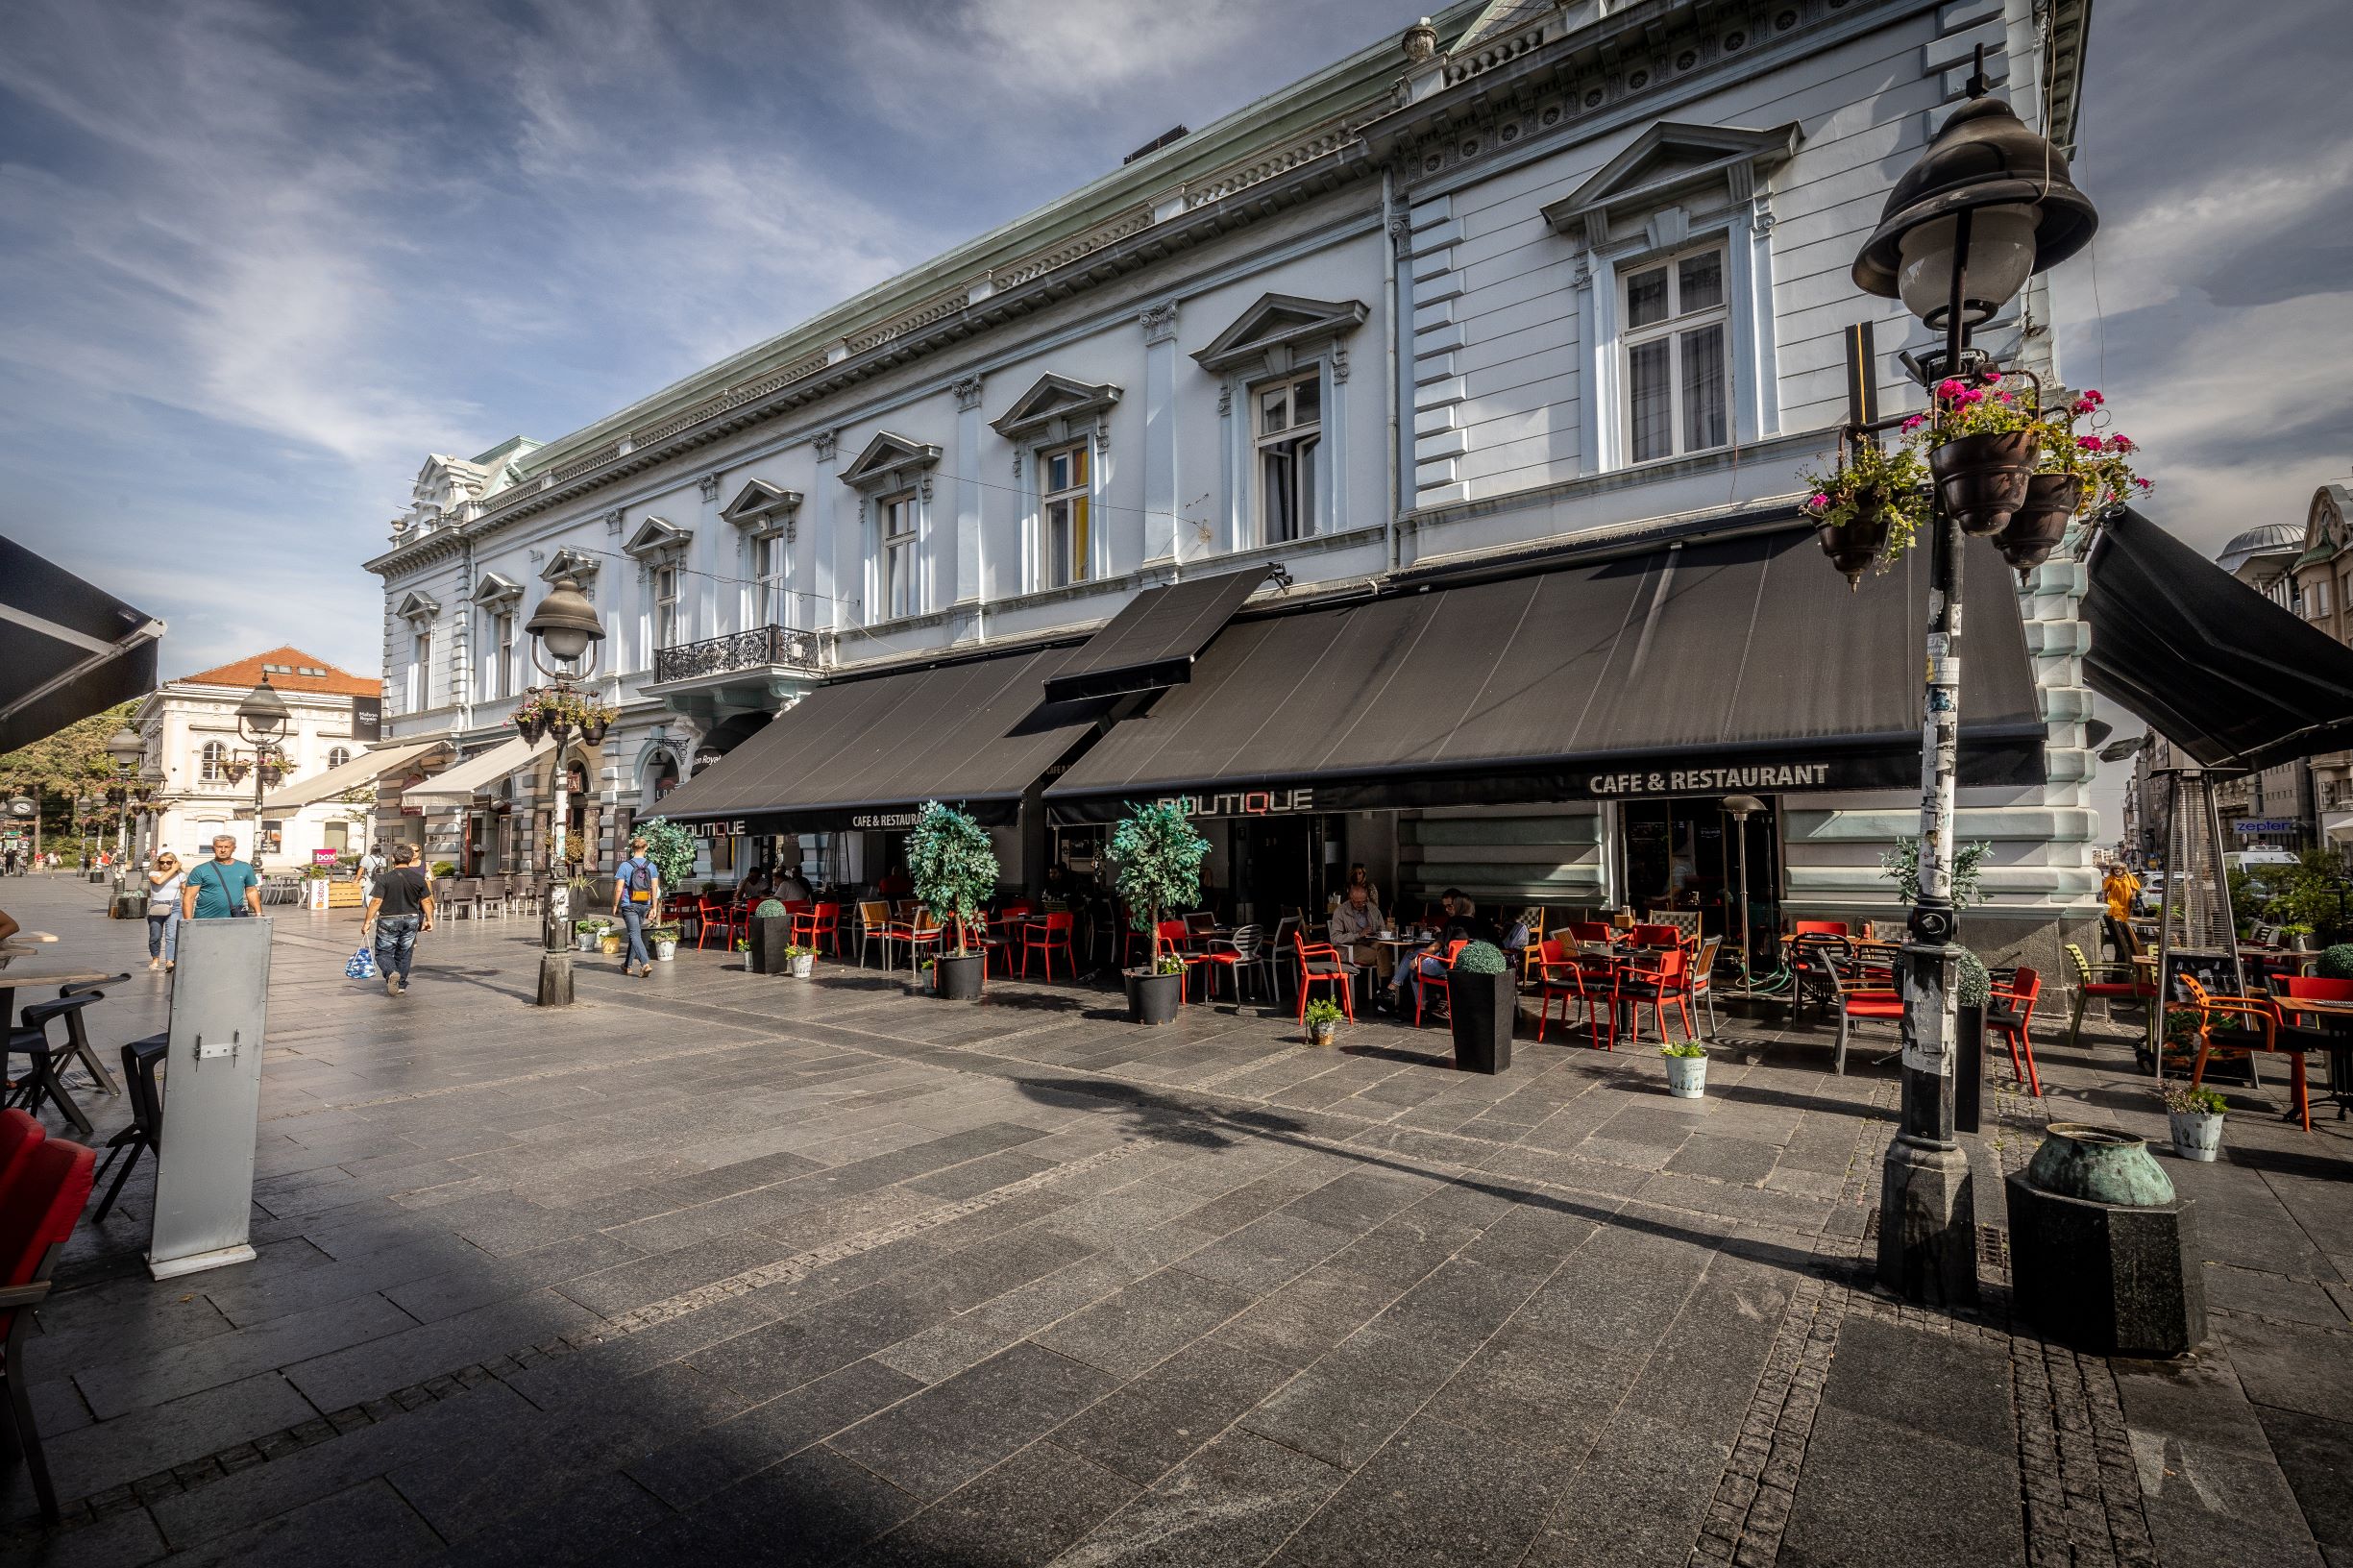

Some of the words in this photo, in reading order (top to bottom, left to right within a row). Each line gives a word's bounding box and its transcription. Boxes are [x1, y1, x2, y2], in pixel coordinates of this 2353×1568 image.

[1589, 772, 1643, 794] CAFE
[1647, 772, 1666, 791] &
[1671, 763, 1829, 790] RESTAURANT
[852, 816, 871, 827] CAFE
[872, 815, 879, 826] &
[2237, 821, 2292, 833] zepter
